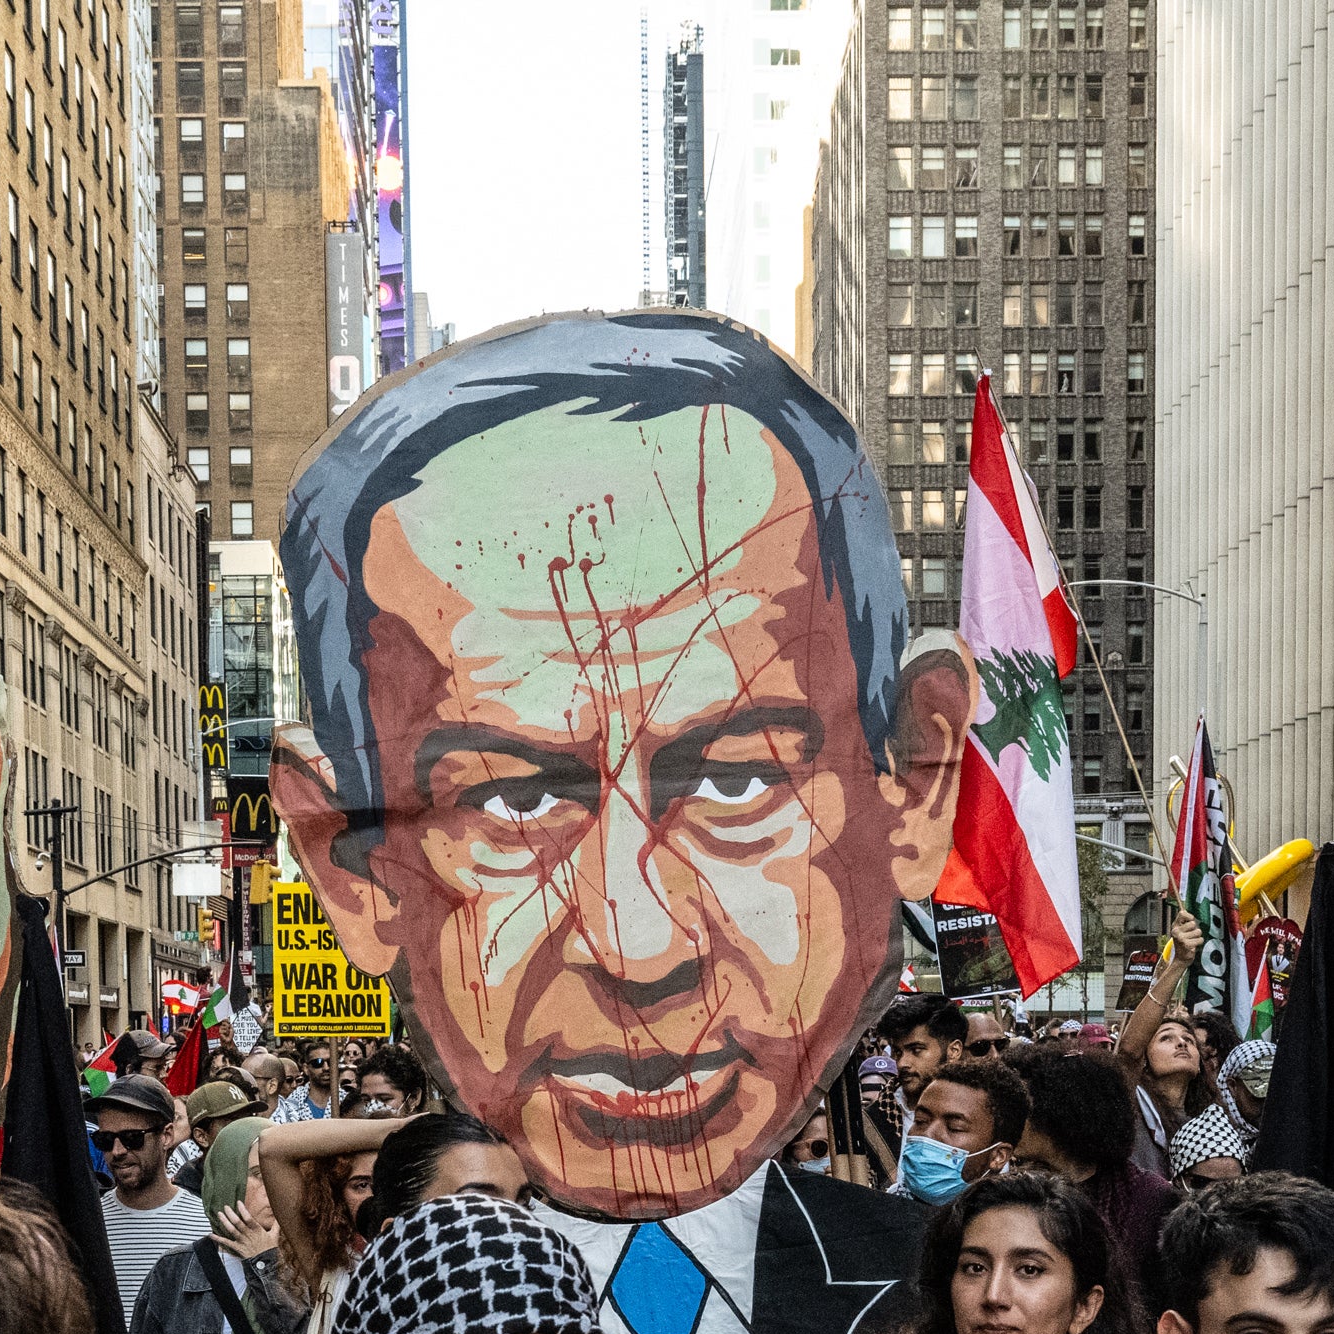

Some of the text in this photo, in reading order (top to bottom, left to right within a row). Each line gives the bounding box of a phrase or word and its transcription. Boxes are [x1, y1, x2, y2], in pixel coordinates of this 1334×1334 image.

[339, 242, 350, 348] TIMES
[936, 913, 999, 933] RESISTA
[280, 963, 338, 990] WAR
[345, 963, 381, 990] ON
[281, 994, 382, 1018] LEBANON
